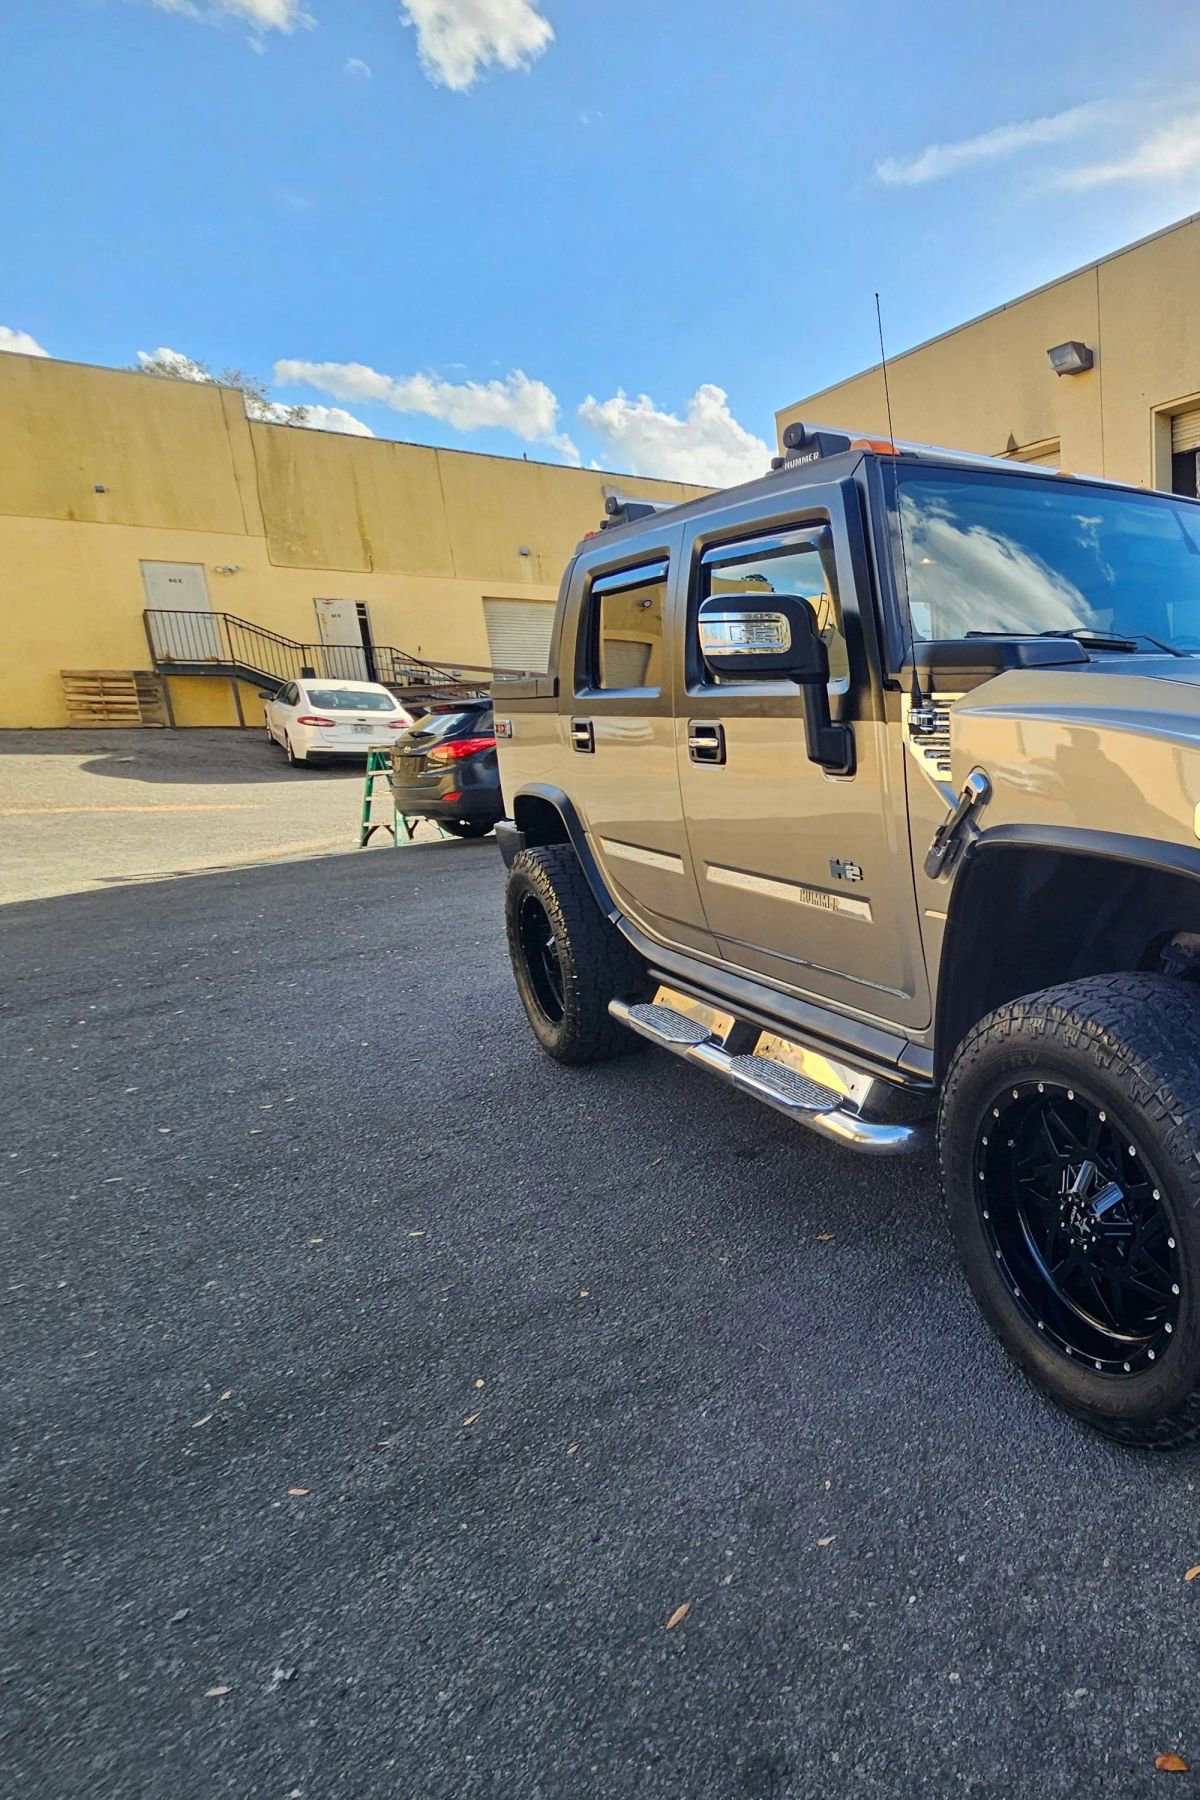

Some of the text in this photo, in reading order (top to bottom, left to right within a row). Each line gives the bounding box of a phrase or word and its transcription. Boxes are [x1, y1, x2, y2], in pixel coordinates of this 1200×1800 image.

[784, 451, 819, 470] HUMMER
[829, 857, 863, 882] H2
[800, 889, 840, 911] HUMMER
